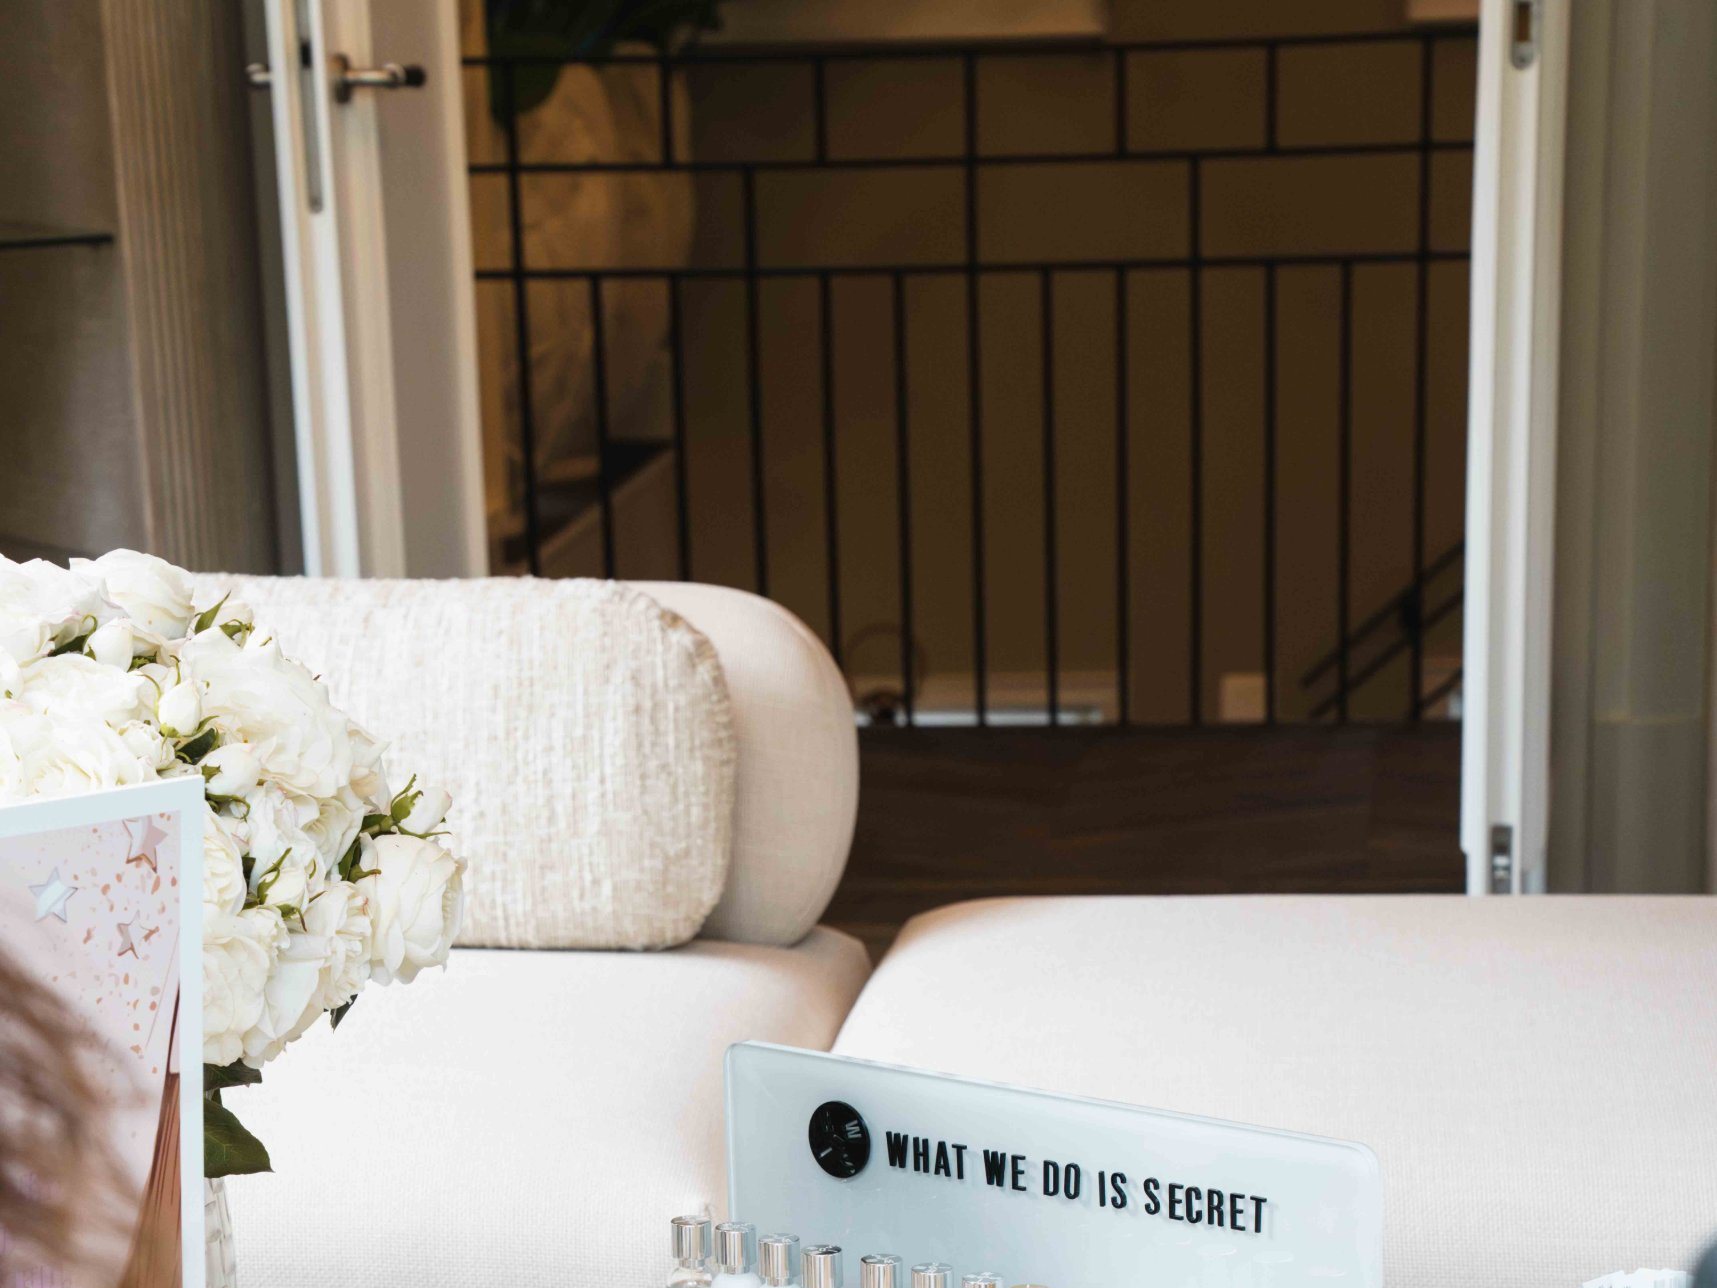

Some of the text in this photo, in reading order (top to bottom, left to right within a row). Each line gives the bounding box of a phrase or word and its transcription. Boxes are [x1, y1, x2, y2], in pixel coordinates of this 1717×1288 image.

[885, 1131, 1268, 1234] WHAT WE DO IS SECRET
